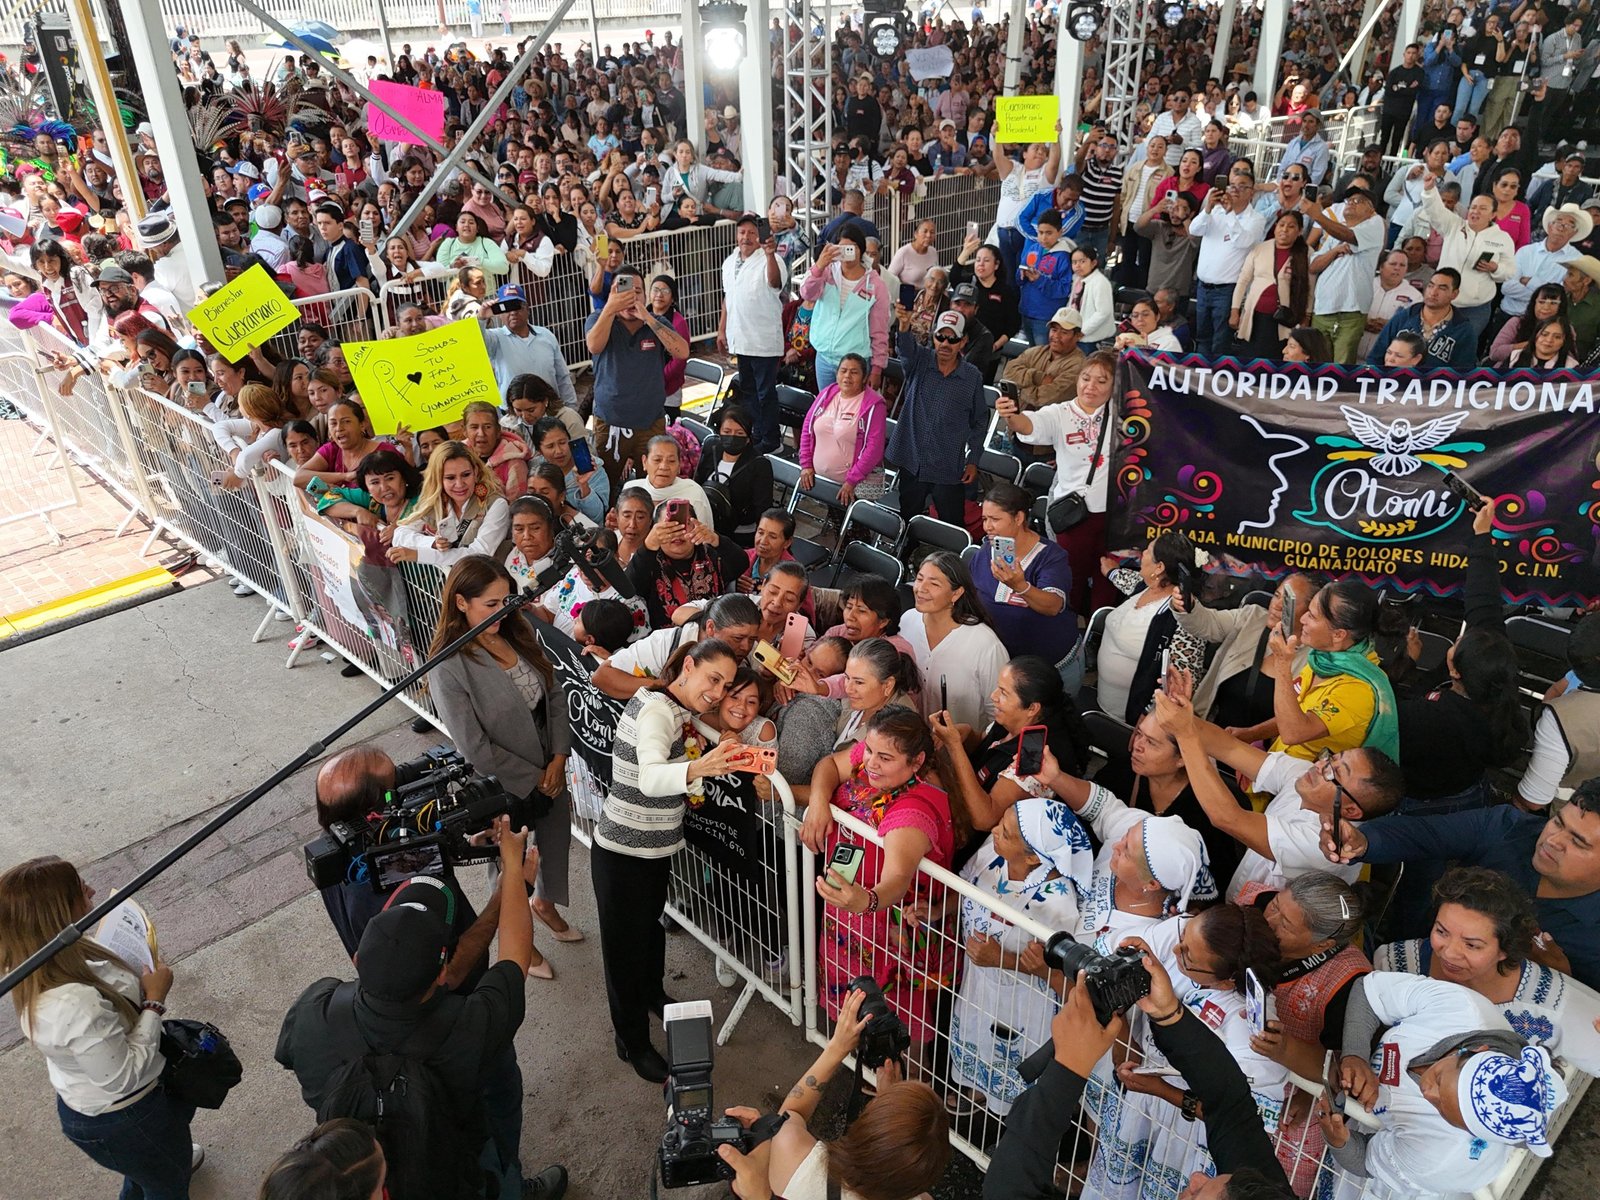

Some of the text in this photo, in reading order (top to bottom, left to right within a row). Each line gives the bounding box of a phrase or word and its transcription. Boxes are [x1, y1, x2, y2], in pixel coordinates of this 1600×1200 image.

[424, 356, 444, 367] TU
[428, 364, 456, 380] FAN
[1148, 366, 1600, 414] AUTORIDAD TRADICIONA
[420, 383, 489, 418] GUANAJUATO
[1226, 533, 1312, 556] MUNICIPIO
[1318, 544, 1339, 558] DE
[1346, 545, 1424, 565] DOLORES
[1515, 562, 1563, 579] C.I.N.
[1284, 553, 1397, 575] GUANAJUATO
[728, 825, 738, 839] DE
[1301, 952, 1327, 970] MIU
